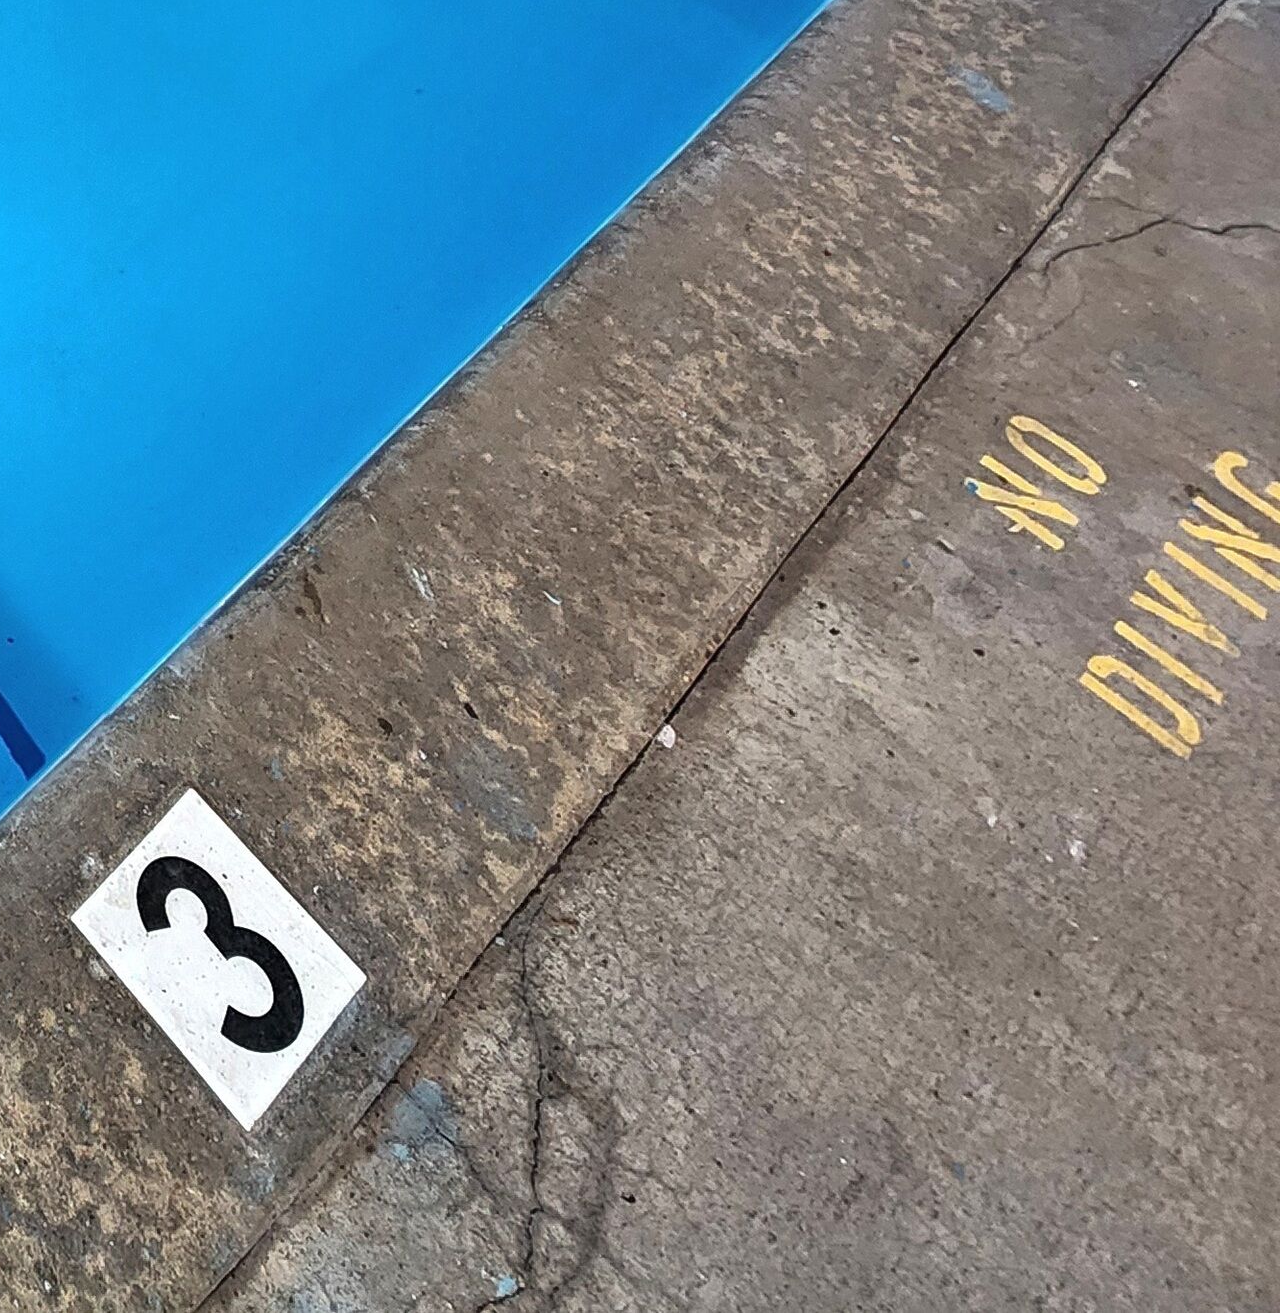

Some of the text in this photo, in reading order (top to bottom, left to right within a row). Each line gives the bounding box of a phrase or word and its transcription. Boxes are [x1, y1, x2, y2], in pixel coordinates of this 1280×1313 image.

[964, 415, 1107, 550] NO
[1079, 450, 1280, 759] DIVING
[136, 855, 305, 1053] 3
